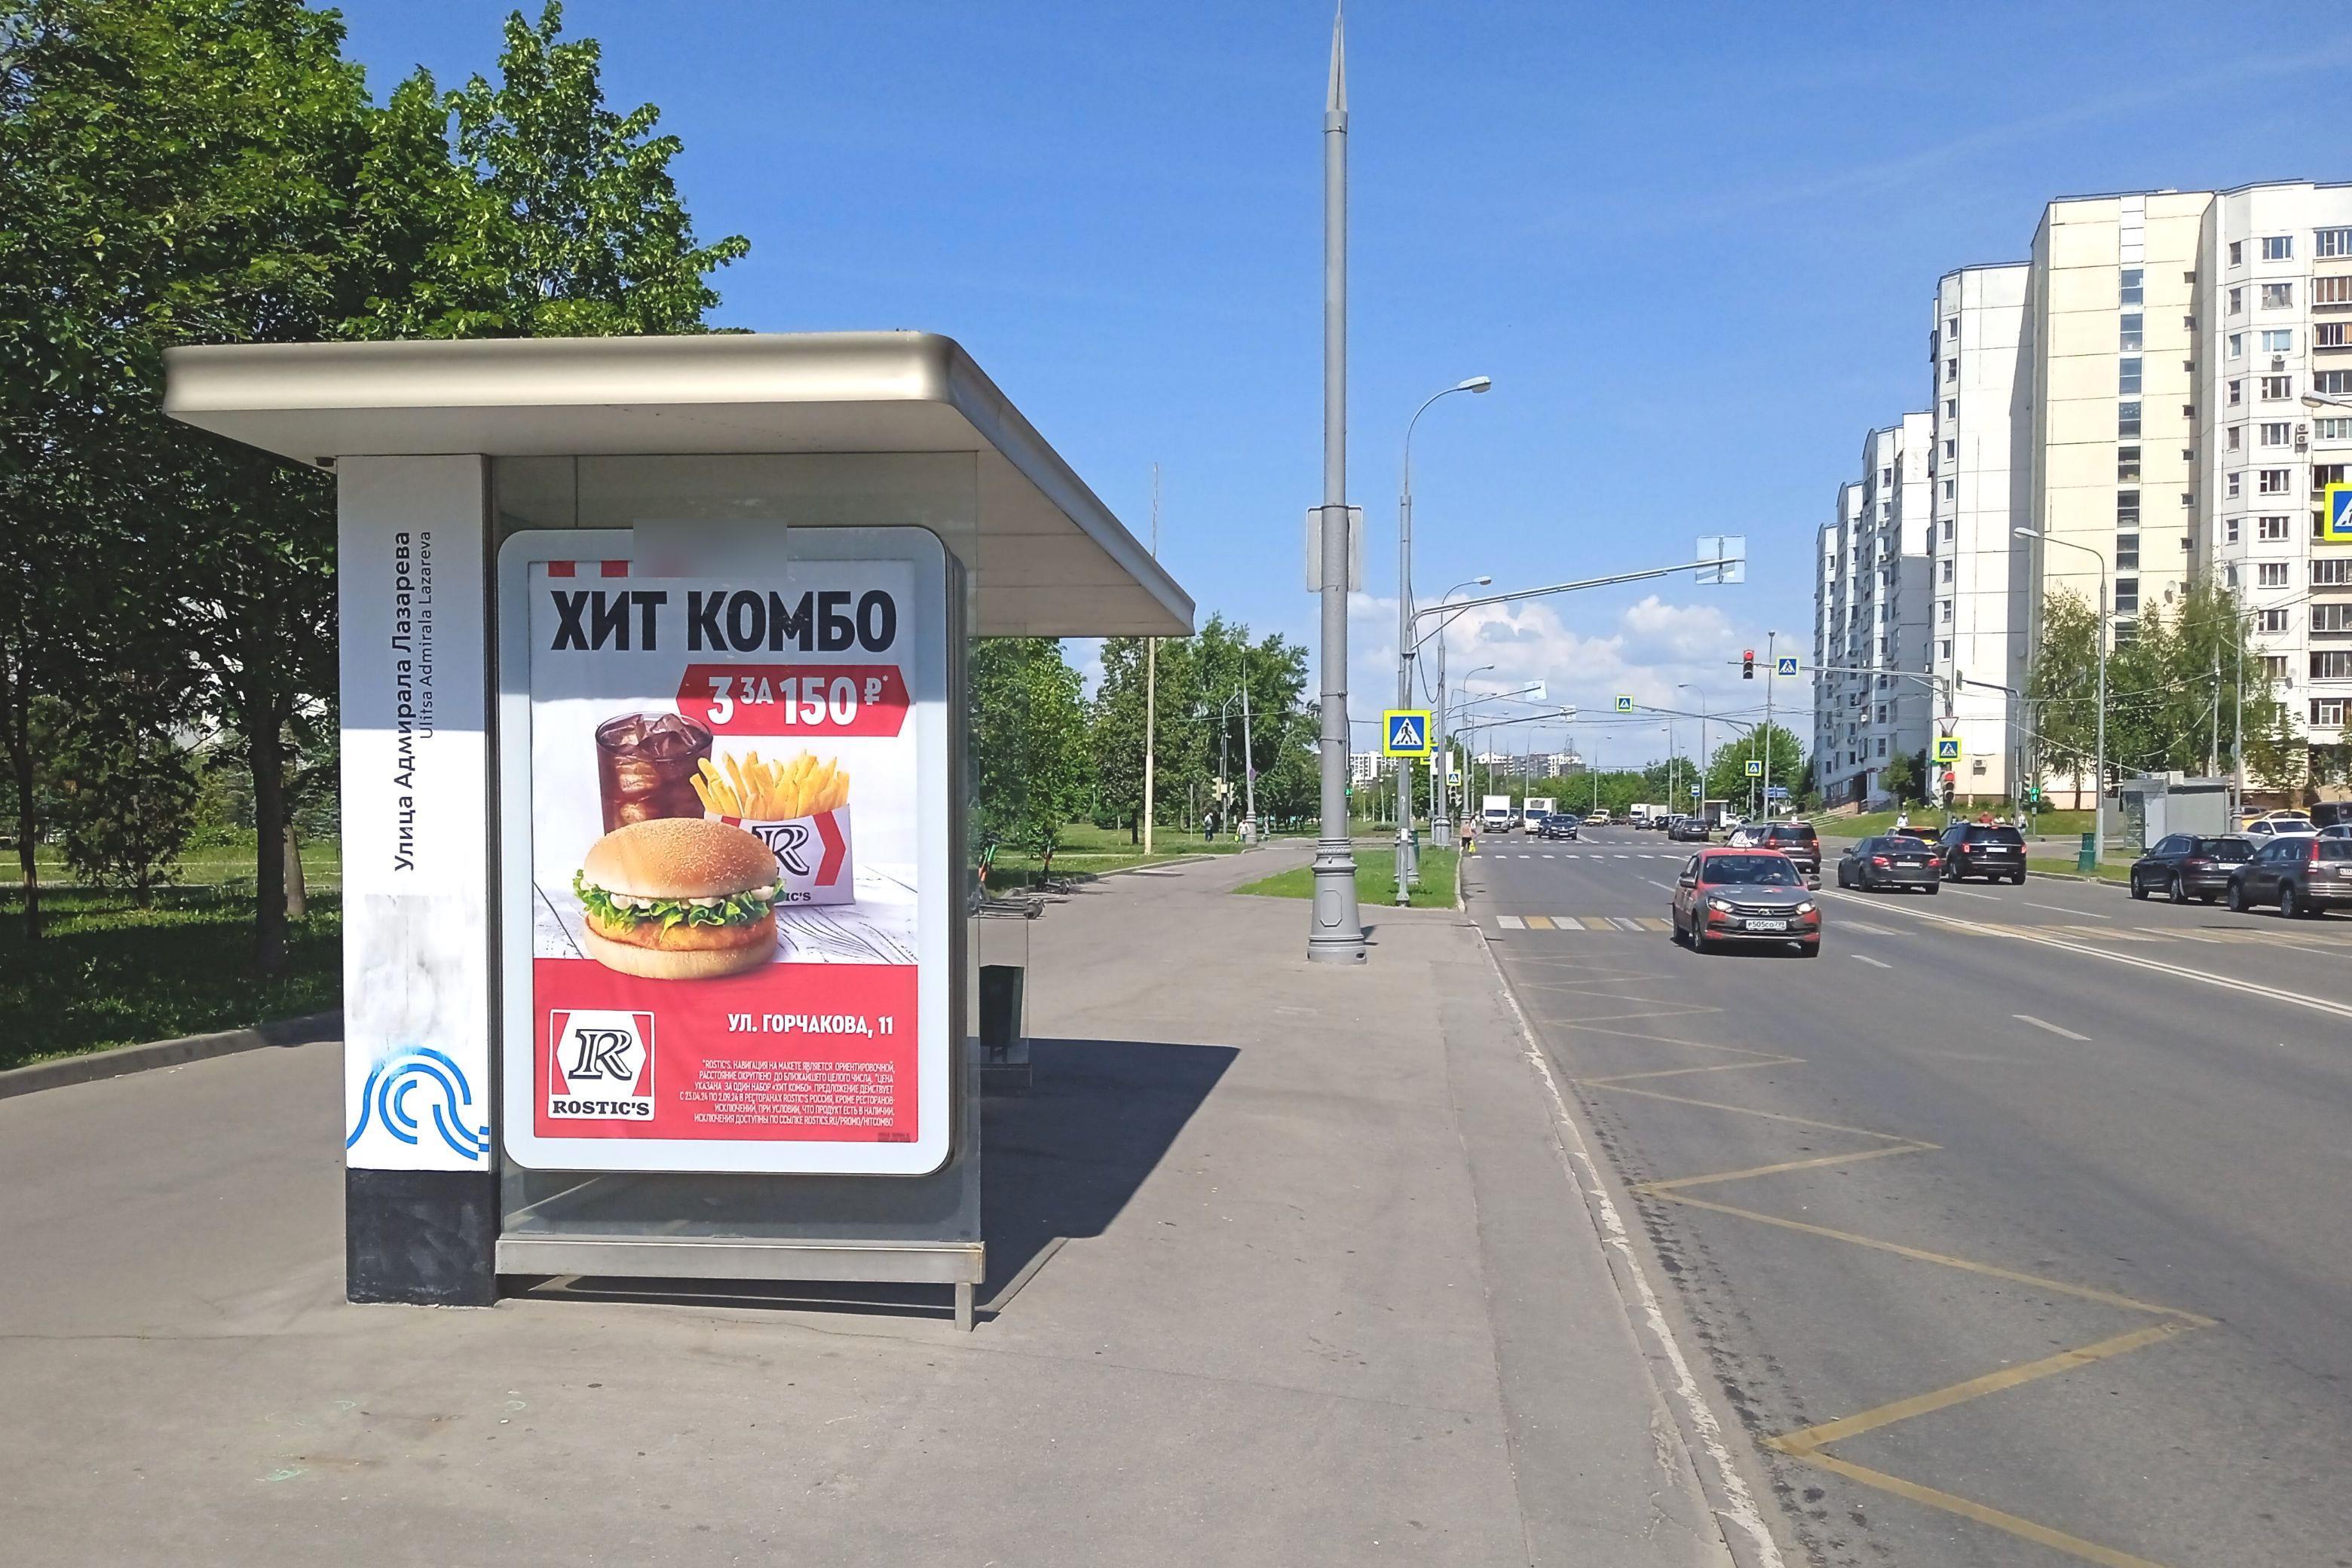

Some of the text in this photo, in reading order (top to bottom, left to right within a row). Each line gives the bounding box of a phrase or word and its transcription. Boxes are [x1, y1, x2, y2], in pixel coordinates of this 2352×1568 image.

[550, 590, 897, 653] ХИТ КОМБО
[418, 531, 433, 739] Ulitsa Admirala Lazareva
[392, 531, 416, 871] Улица Адмирала Лазарева
[707, 677, 734, 724] 3
[740, 677, 774, 705] ЗА
[779, 676, 858, 725] 150
[786, 892, 811, 902] IC'S
[727, 1013, 893, 1039] УЛ. ГОРЧАКОВА, 11
[733, 1061, 768, 1071] НАВИГАЦИЯ
[779, 1062, 802, 1070] МАКЕТЕ
[803, 1062, 833, 1071] ЯВЛЯЕТСЯ
[700, 1070, 737, 1080] РАССТОЯНИЕ
[738, 1071, 772, 1081] ОКРУГЛЕНО
[774, 1073, 783, 1082] ДО
[784, 1071, 826, 1082] БЛИЖАЙШЕГО
[828, 1073, 850, 1083] ЦЕЛОГО
[694, 1081, 722, 1091] УКАЗАНА
[724, 1083, 732, 1091] ЗА
[733, 1083, 750, 1092] ОДИН
[751, 1083, 771, 1092] НАБОР
[814, 1084, 859, 1094] ПРЕДЛОЖЕНИЕ
[859, 1084, 893, 1094] ДЕЙСТВУЕТ
[709, 1092, 718, 1101] ПО
[745, 1093, 782, 1102] РЕСТОРАНАХ
[835, 1095, 855, 1104] КРОМЕ
[553, 1100, 650, 1116] ROSTIC'S
[758, 1104, 770, 1113] ПРИ
[802, 1105, 814, 1113] ЧТО
[816, 1105, 842, 1116] ПРОДУКТ
[844, 1107, 858, 1115] ЕСТЬ
[694, 1113, 734, 1123] ИСКЛЮЧЕНИЯ
[735, 1114, 769, 1125] ДОСТУПНЫ
[770, 1116, 779, 1124] ПО
[779, 1116, 804, 1125] ССЫЛКЕ
